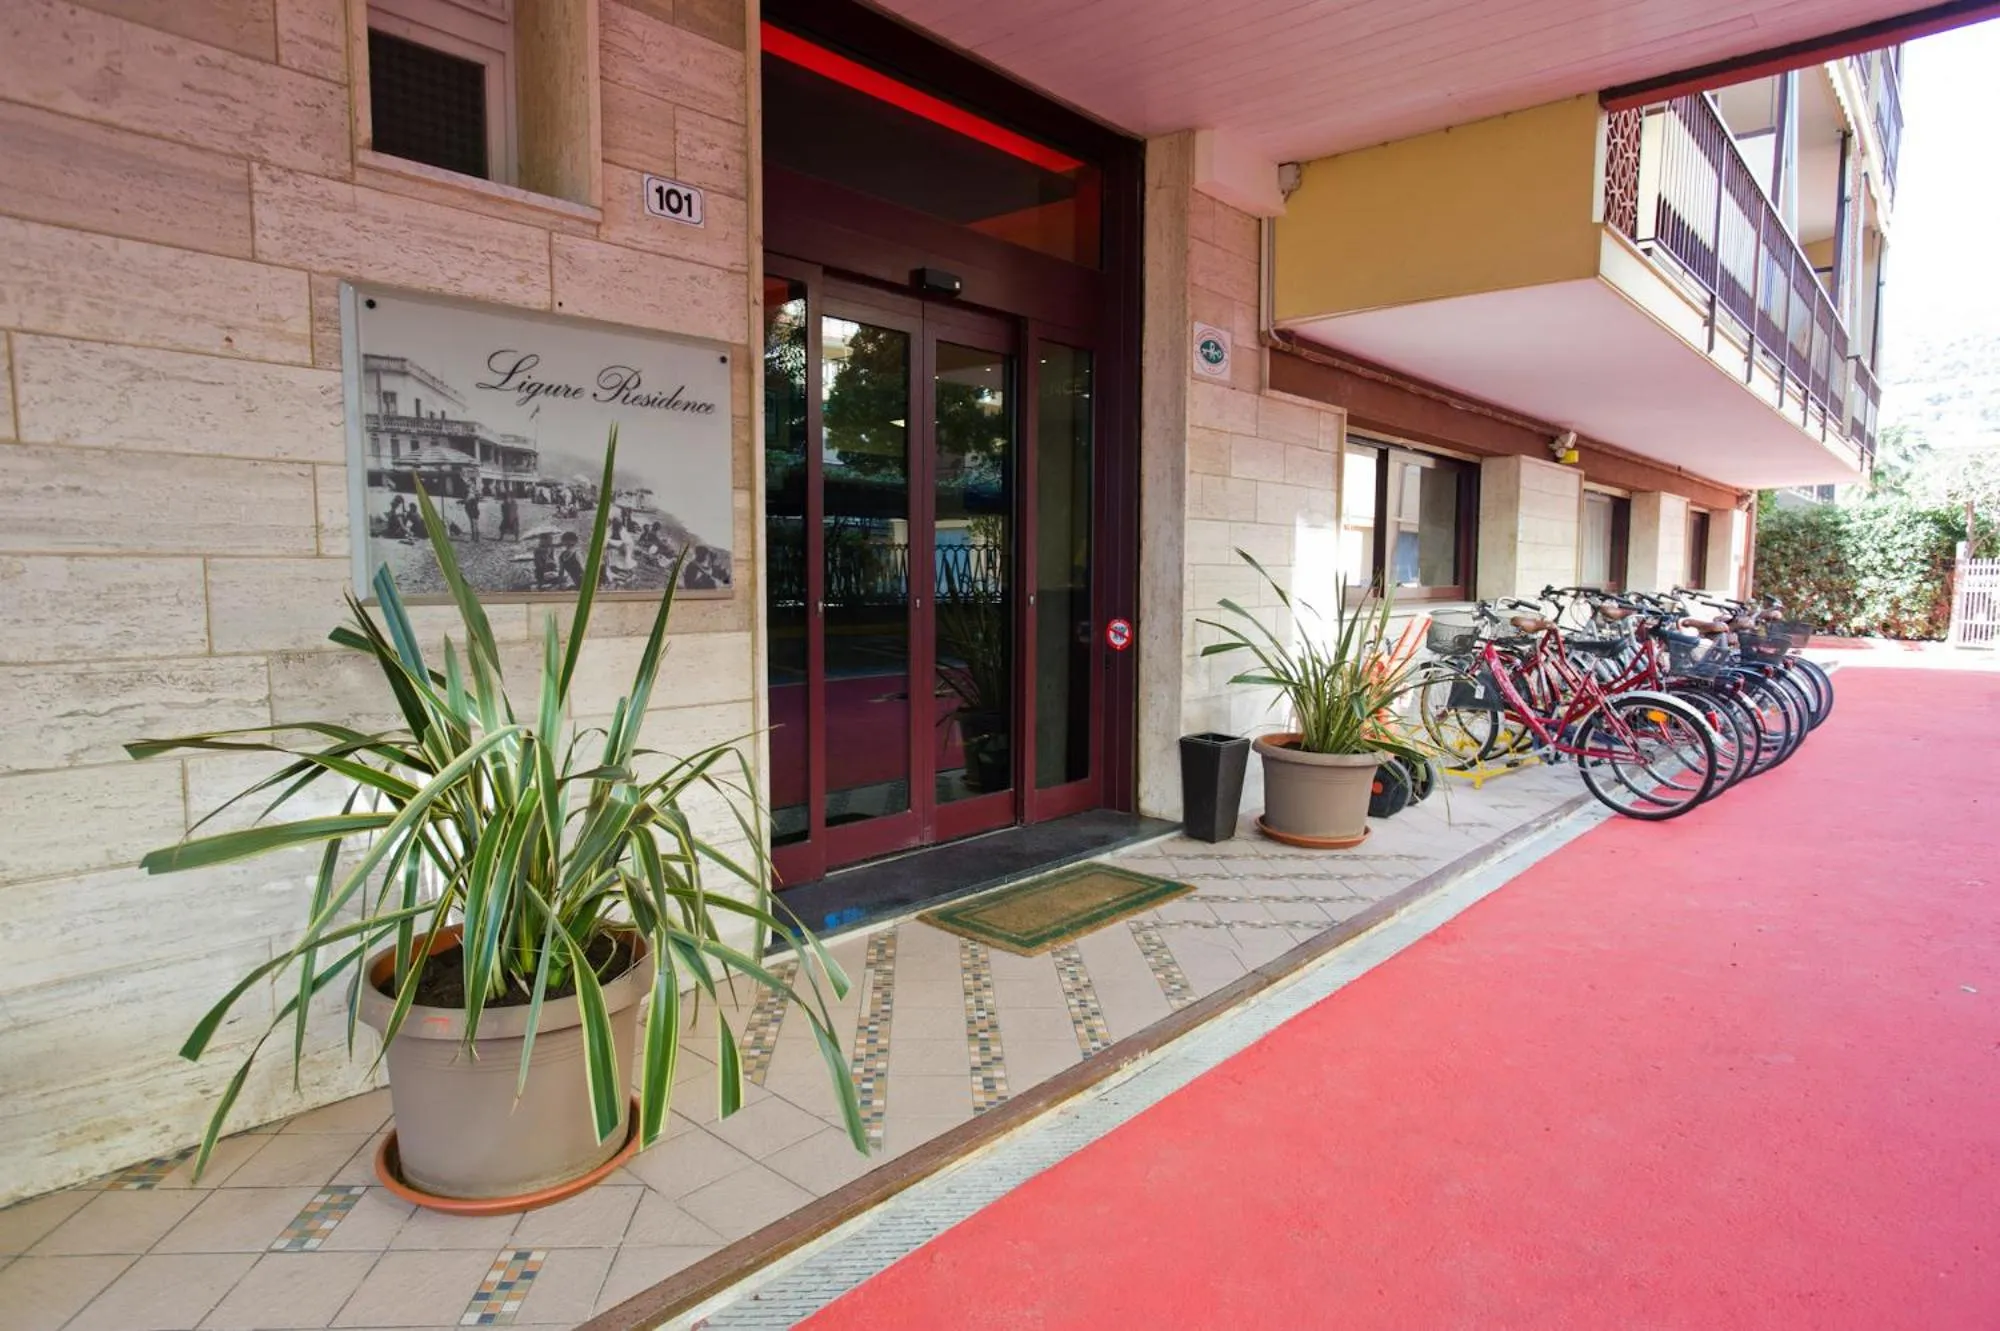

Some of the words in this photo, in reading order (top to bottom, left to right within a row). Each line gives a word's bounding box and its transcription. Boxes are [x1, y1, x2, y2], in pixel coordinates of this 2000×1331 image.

[655, 185, 693, 218] 101
[475, 349, 585, 406] Ligure
[592, 364, 716, 416] Residence
